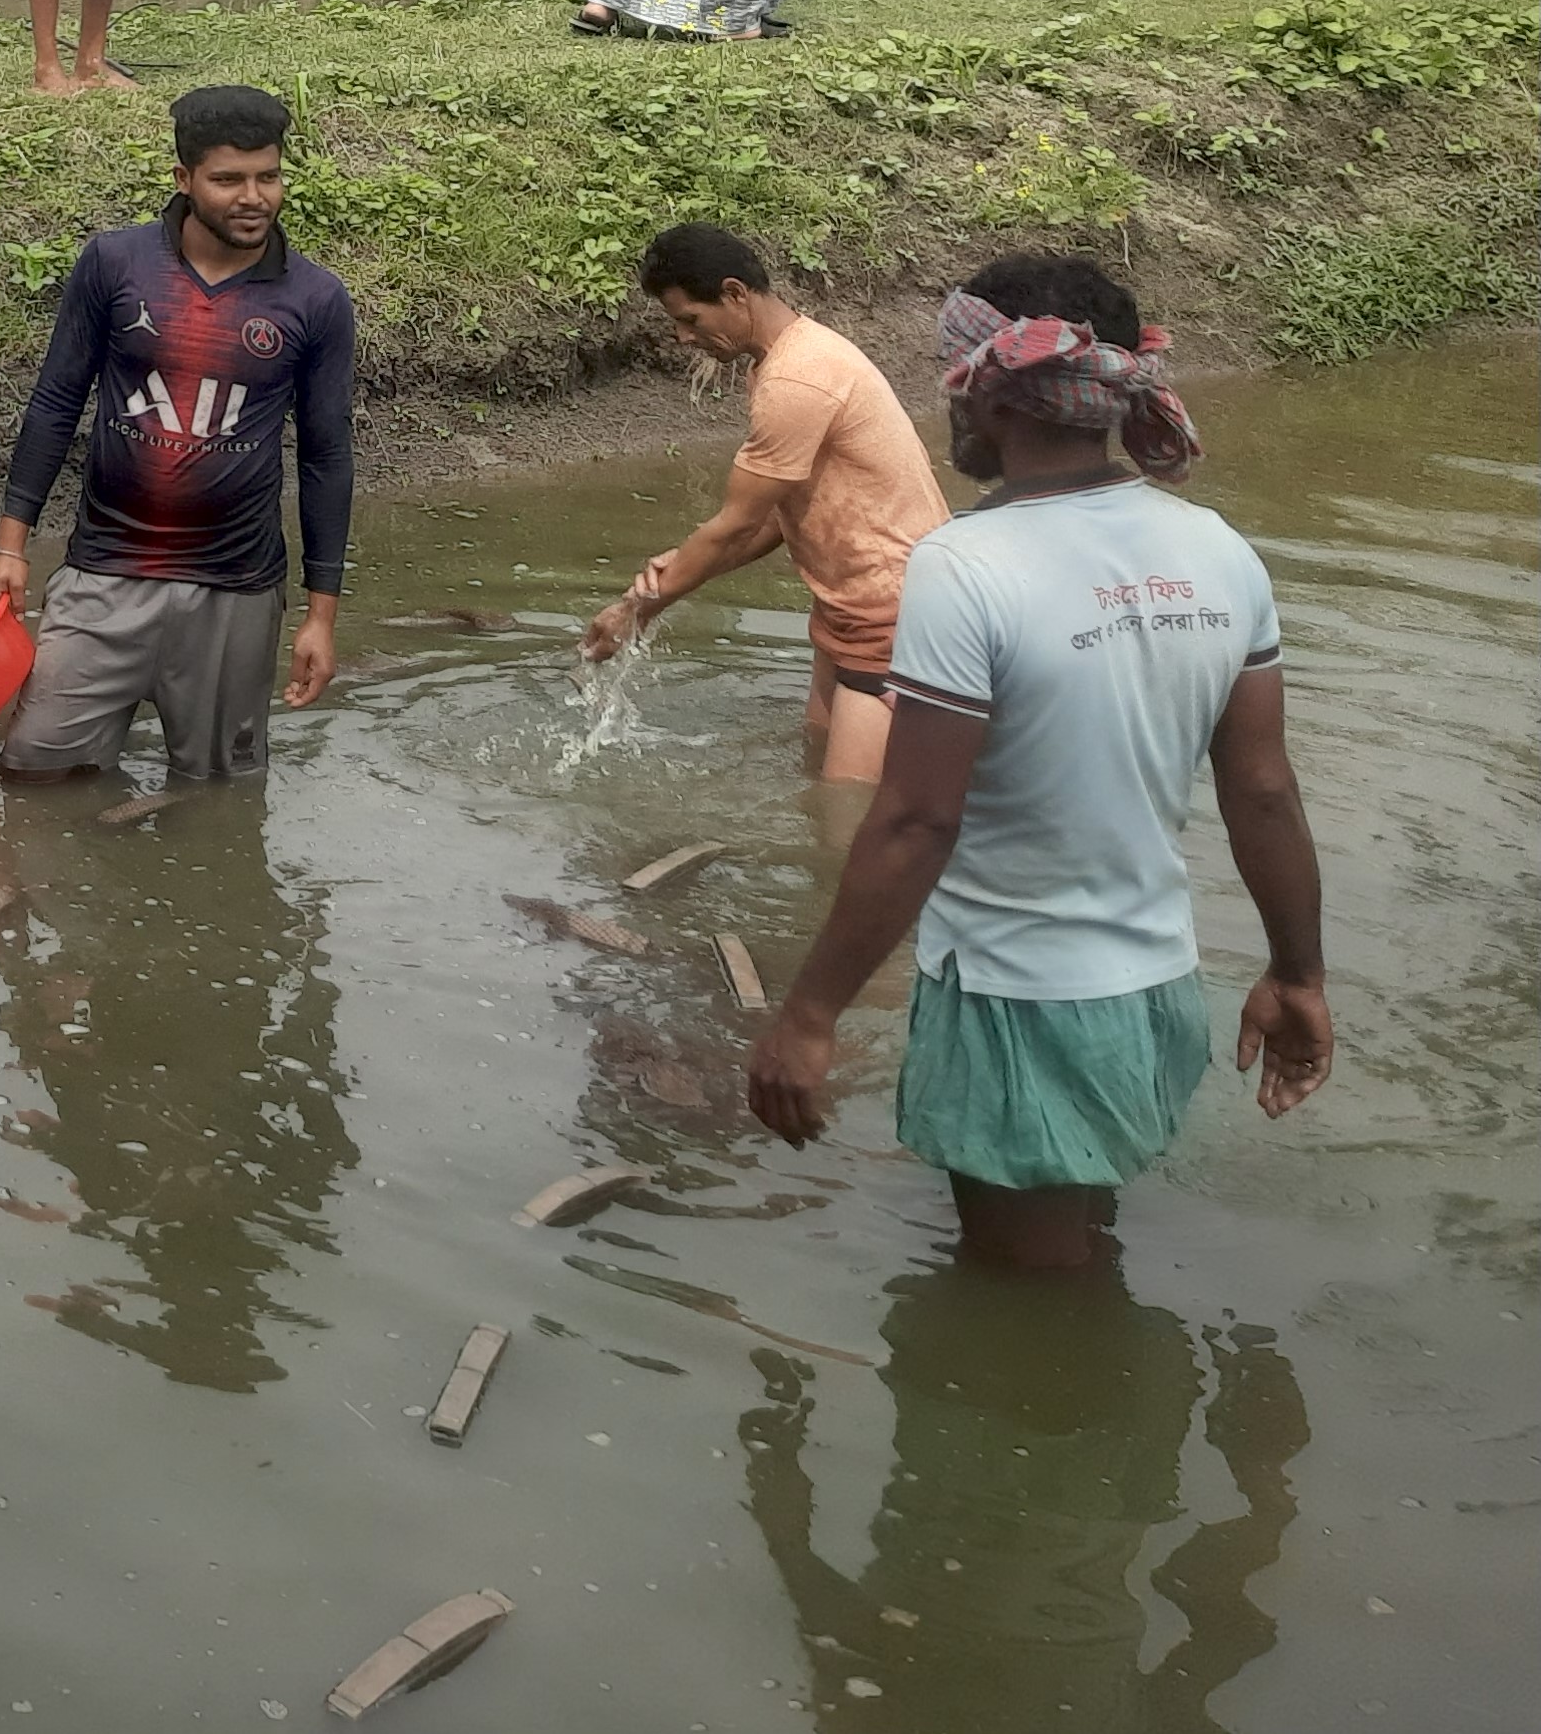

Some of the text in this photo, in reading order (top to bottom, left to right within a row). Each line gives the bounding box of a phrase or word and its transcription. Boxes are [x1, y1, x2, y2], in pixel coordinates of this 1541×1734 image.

[148, 435, 184, 453] LIVE
[187, 440, 261, 454] LMTLESS
[1144, 575, 1195, 604] ফিড
[1151, 613, 1195, 632] সেরা
[1197, 607, 1231, 631] ফিড
